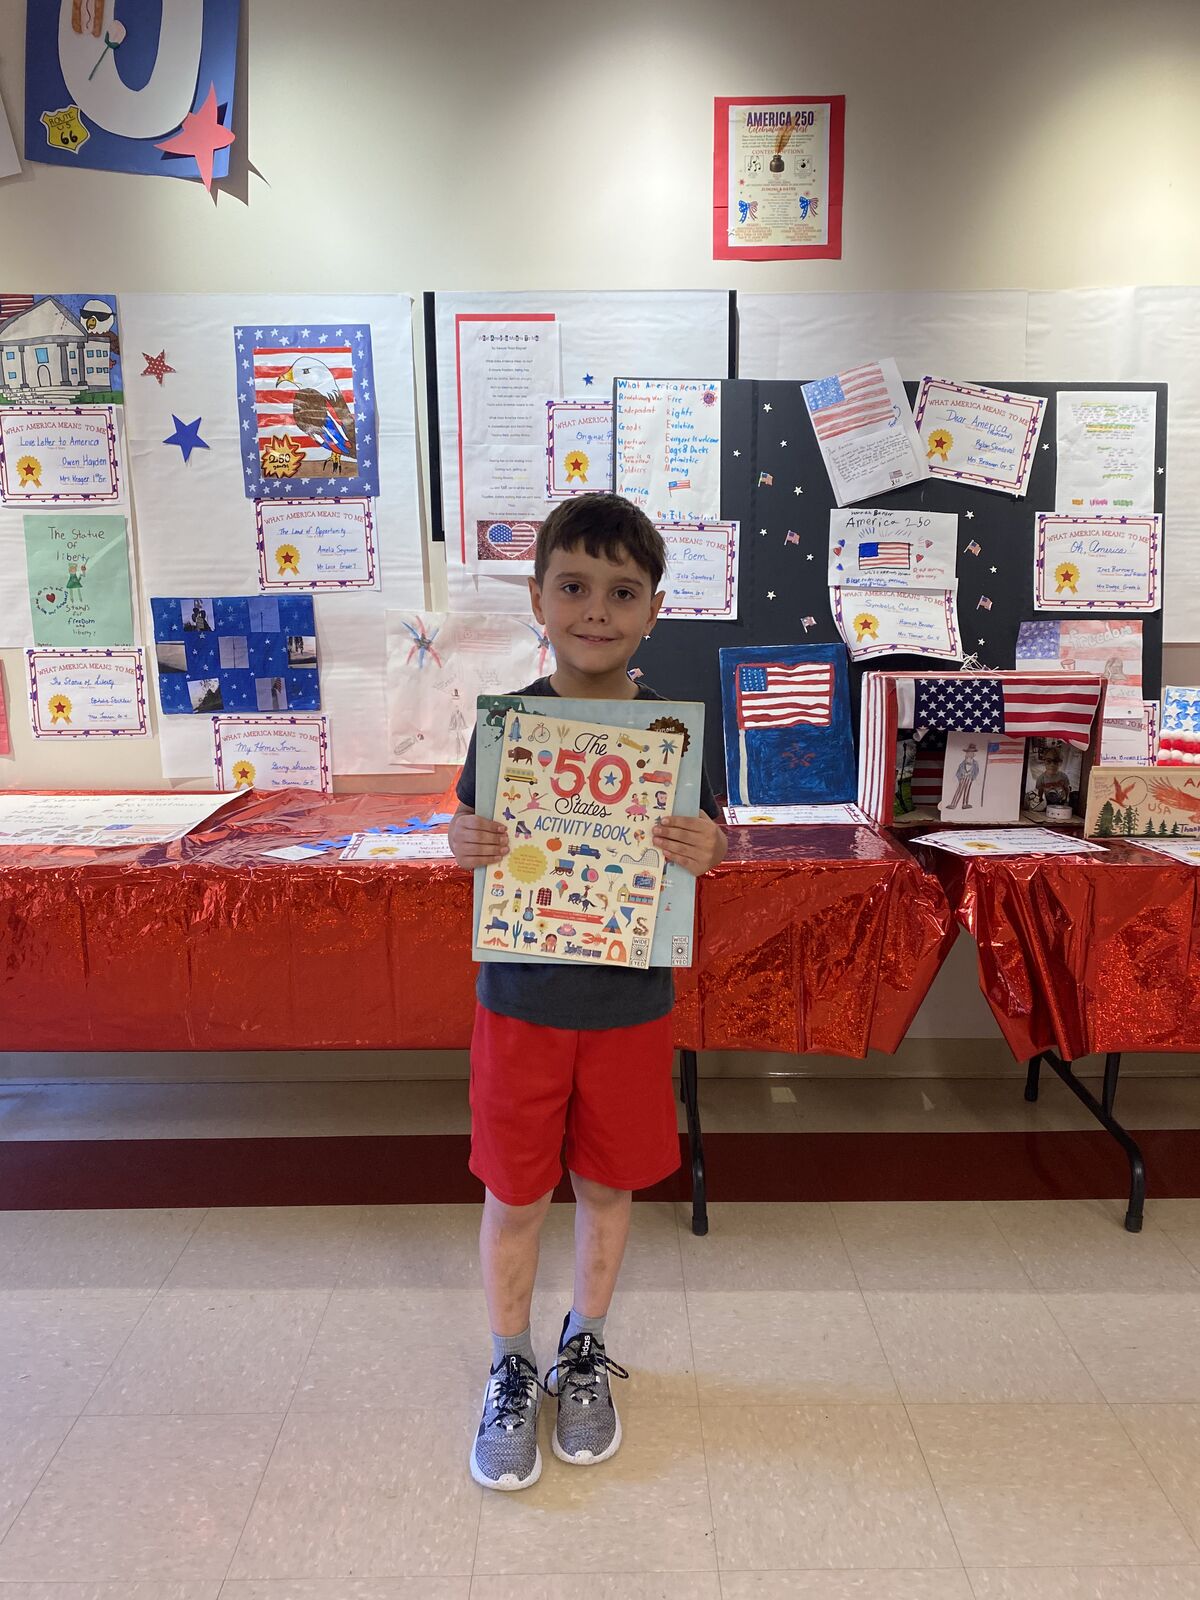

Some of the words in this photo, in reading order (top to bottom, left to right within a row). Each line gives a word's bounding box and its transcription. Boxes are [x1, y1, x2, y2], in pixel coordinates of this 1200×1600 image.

[49, 112, 75, 127] ROUTE
[747, 112, 792, 126] AMERICA
[794, 110, 814, 126] 250
[60, 130, 78, 145] 66
[646, 382, 678, 391] America
[950, 400, 981, 410] AMERICA
[982, 406, 1006, 416] MEANS
[1008, 413, 1018, 421] TO
[1019, 418, 1030, 427] ME
[4, 426, 24, 435] WHAT
[26, 422, 57, 431] AMERICA
[85, 424, 95, 432] TO
[96, 426, 107, 435] ME
[556, 420, 576, 430] WHAT
[578, 416, 609, 425] AMERICA
[947, 410, 966, 424] Dear
[972, 415, 1008, 433] America
[59, 436, 67, 446] to
[70, 436, 100, 446] America
[62, 456, 80, 466] Owen
[268, 454, 291, 464] 250
[618, 484, 649, 495] America
[264, 515, 284, 525] WHAT
[285, 510, 316, 520] AMERICA
[343, 512, 356, 521] TO
[356, 514, 364, 523] ME
[846, 517, 898, 528] America
[905, 517, 931, 528] 250
[48, 526, 66, 540] The
[71, 528, 106, 540] Statue
[315, 526, 346, 538] Opportunity
[1047, 533, 1068, 542] WHAT
[1070, 530, 1100, 538] AMERICA
[1139, 535, 1149, 544] ME
[680, 537, 703, 545] MEANS
[717, 543, 726, 551] ME
[683, 548, 708, 560] Poem
[864, 590, 895, 598] AMERICA
[38, 667, 57, 675] WHAT
[58, 663, 88, 671] AMERICA
[125, 667, 135, 675] ME
[94, 674, 115, 689] Liberty
[222, 734, 241, 742] WHAT
[243, 730, 272, 738] AMERICA
[236, 742, 251, 755] My
[254, 742, 278, 752] Home
[277, 740, 300, 752] Town
[572, 732, 609, 756] The
[550, 748, 633, 805] 50
[554, 794, 612, 818] States
[1148, 803, 1172, 815] USA
[534, 815, 591, 838] ACTIVITY
[592, 822, 632, 846] BOOK
[581, 1335, 591, 1356] idas
